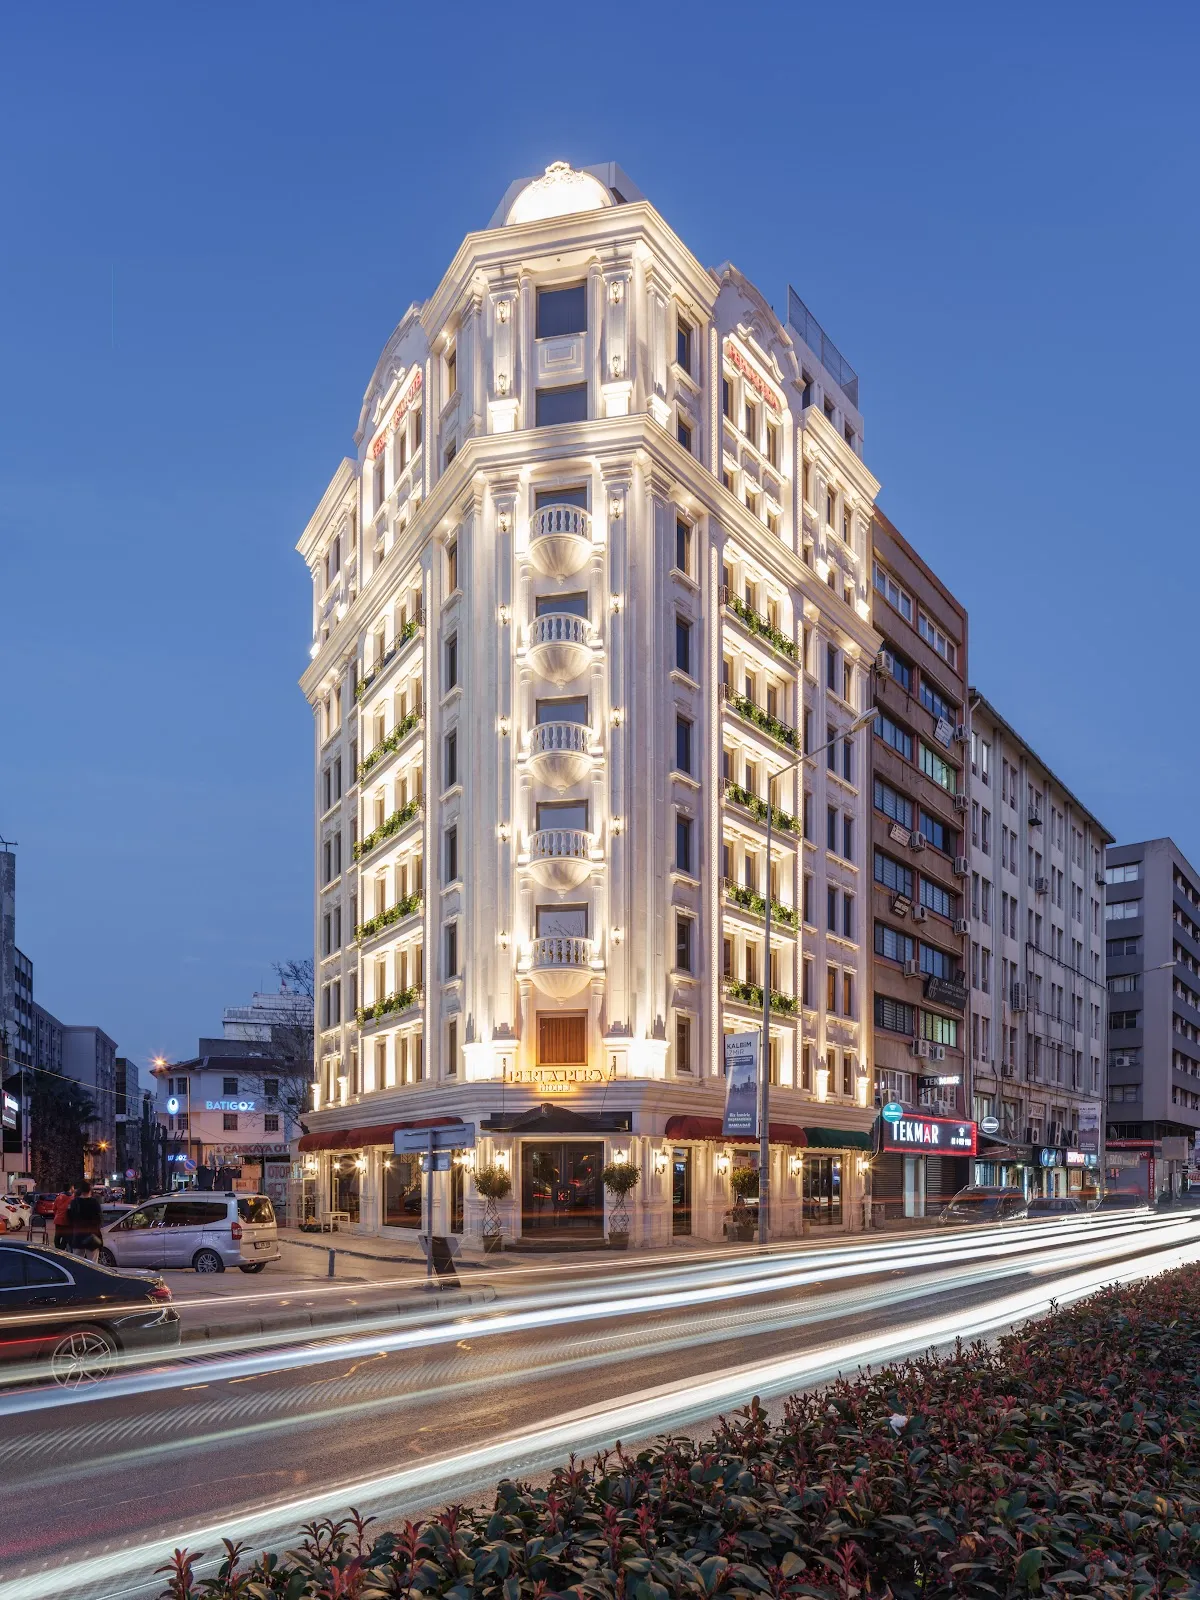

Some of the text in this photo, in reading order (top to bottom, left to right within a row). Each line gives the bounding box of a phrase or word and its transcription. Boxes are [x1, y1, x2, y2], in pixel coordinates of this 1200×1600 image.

[510, 1069, 607, 1083] PERLA PURA
[924, 1075, 960, 1086] TEKMAR
[892, 1120, 939, 1144] TEKMAR
